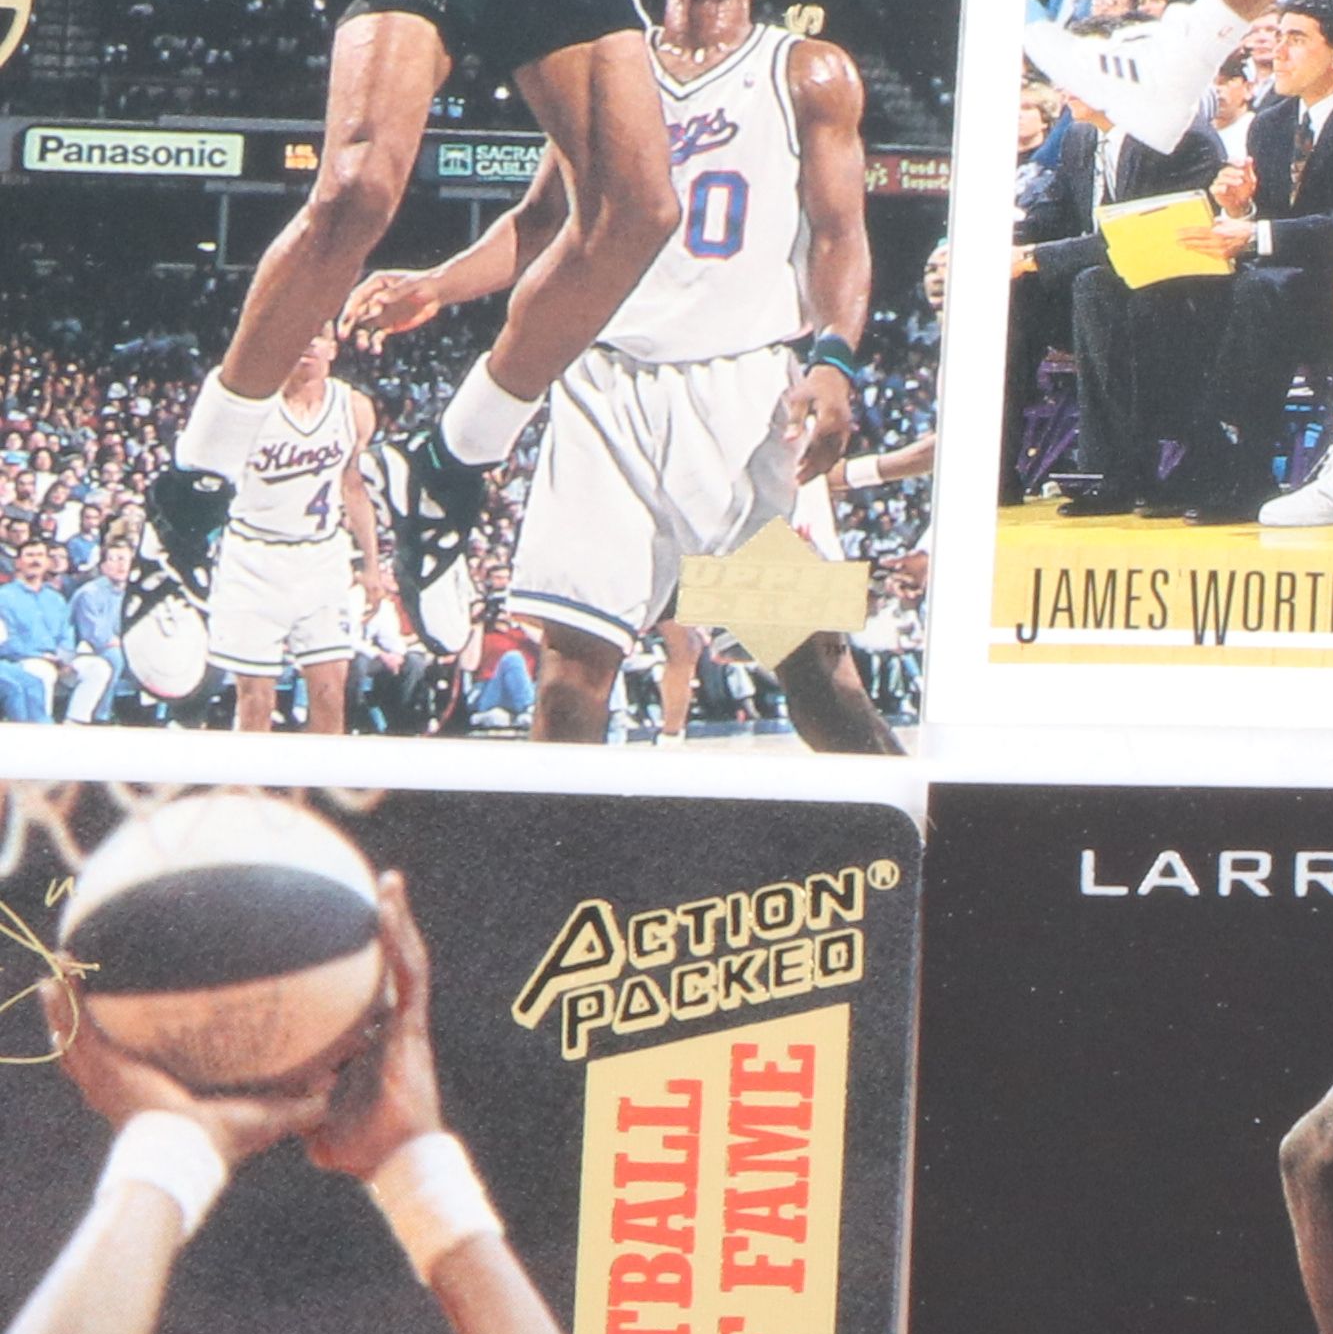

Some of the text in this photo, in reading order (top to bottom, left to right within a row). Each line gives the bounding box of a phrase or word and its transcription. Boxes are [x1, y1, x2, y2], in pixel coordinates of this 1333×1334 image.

[37, 135, 229, 169] Panasonic
[304, 480, 333, 532] 4
[1015, 567, 1170, 645] JAMES
[511, 866, 866, 1030] ACTION
[561, 927, 866, 1061] PACKED
[719, 1043, 816, 1294] FAME
